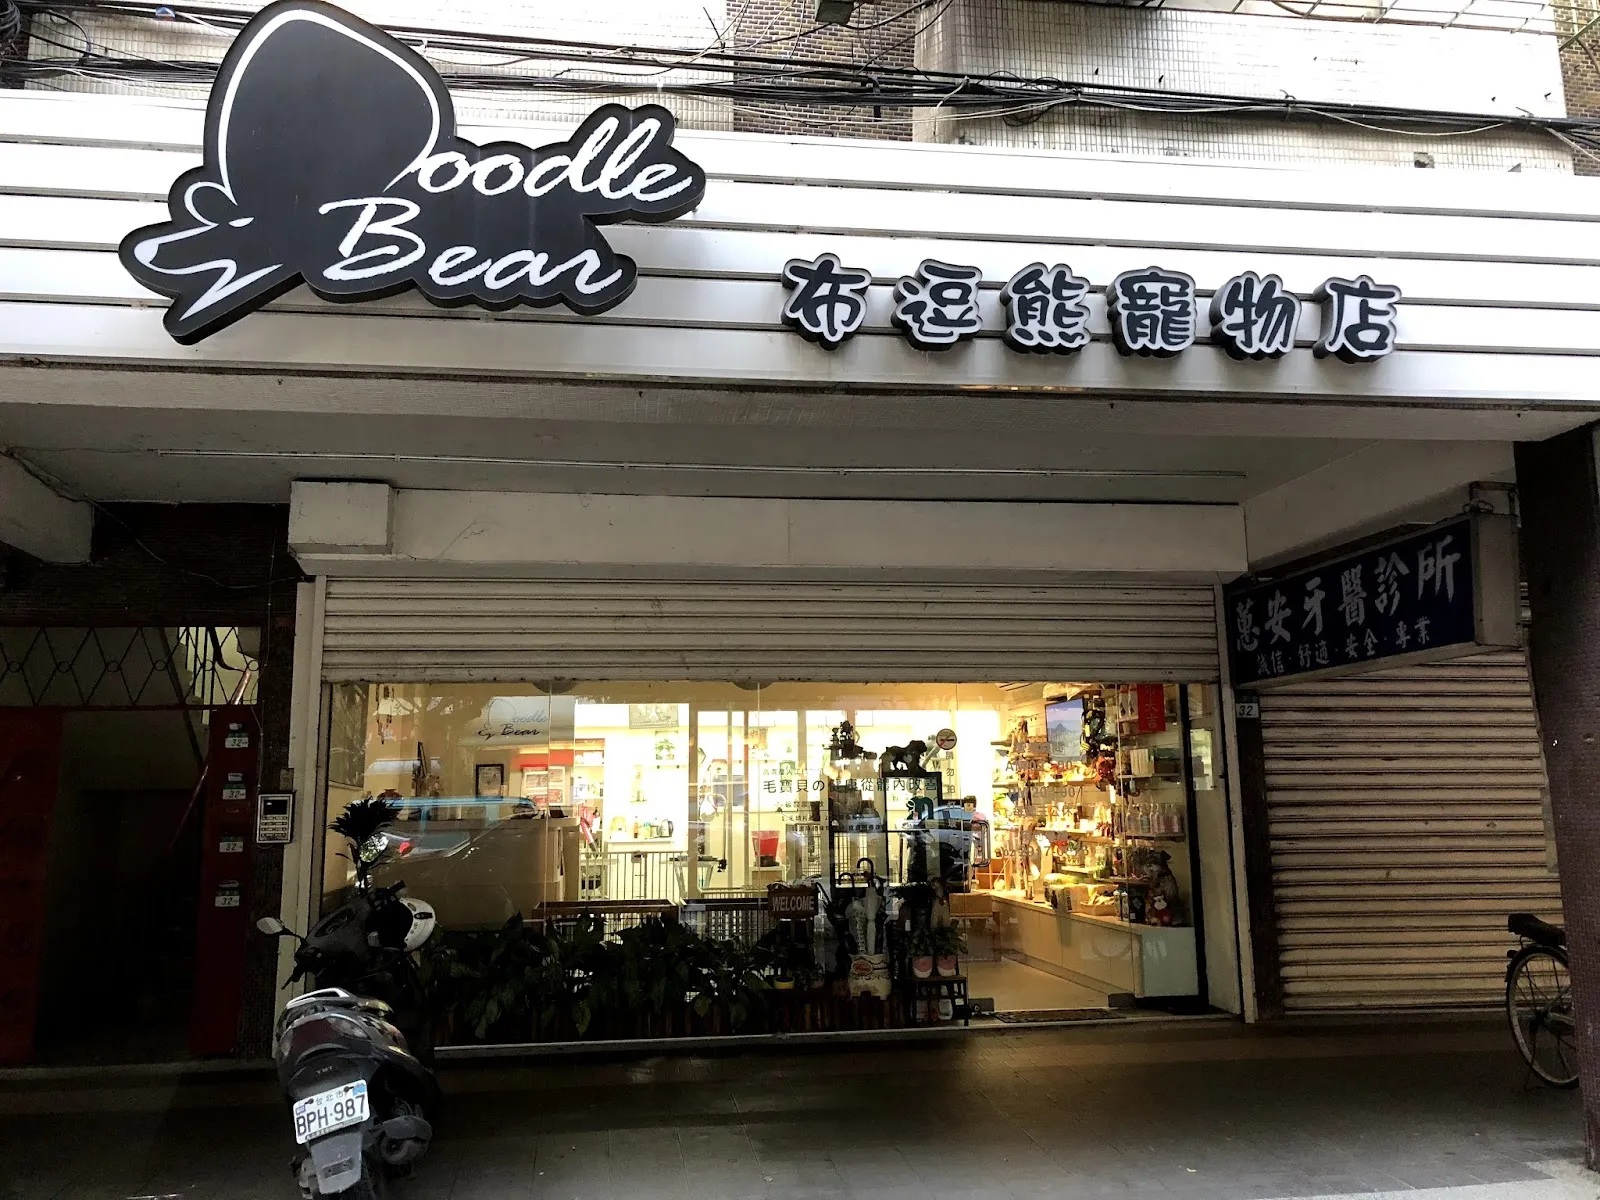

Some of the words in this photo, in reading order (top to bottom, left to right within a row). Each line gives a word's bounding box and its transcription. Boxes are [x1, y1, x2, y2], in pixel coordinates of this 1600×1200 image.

[318, 198, 624, 295] Bear
[784, 254, 1400, 359] 布逗熊寵物店
[772, 896, 815, 912] WELCOME
